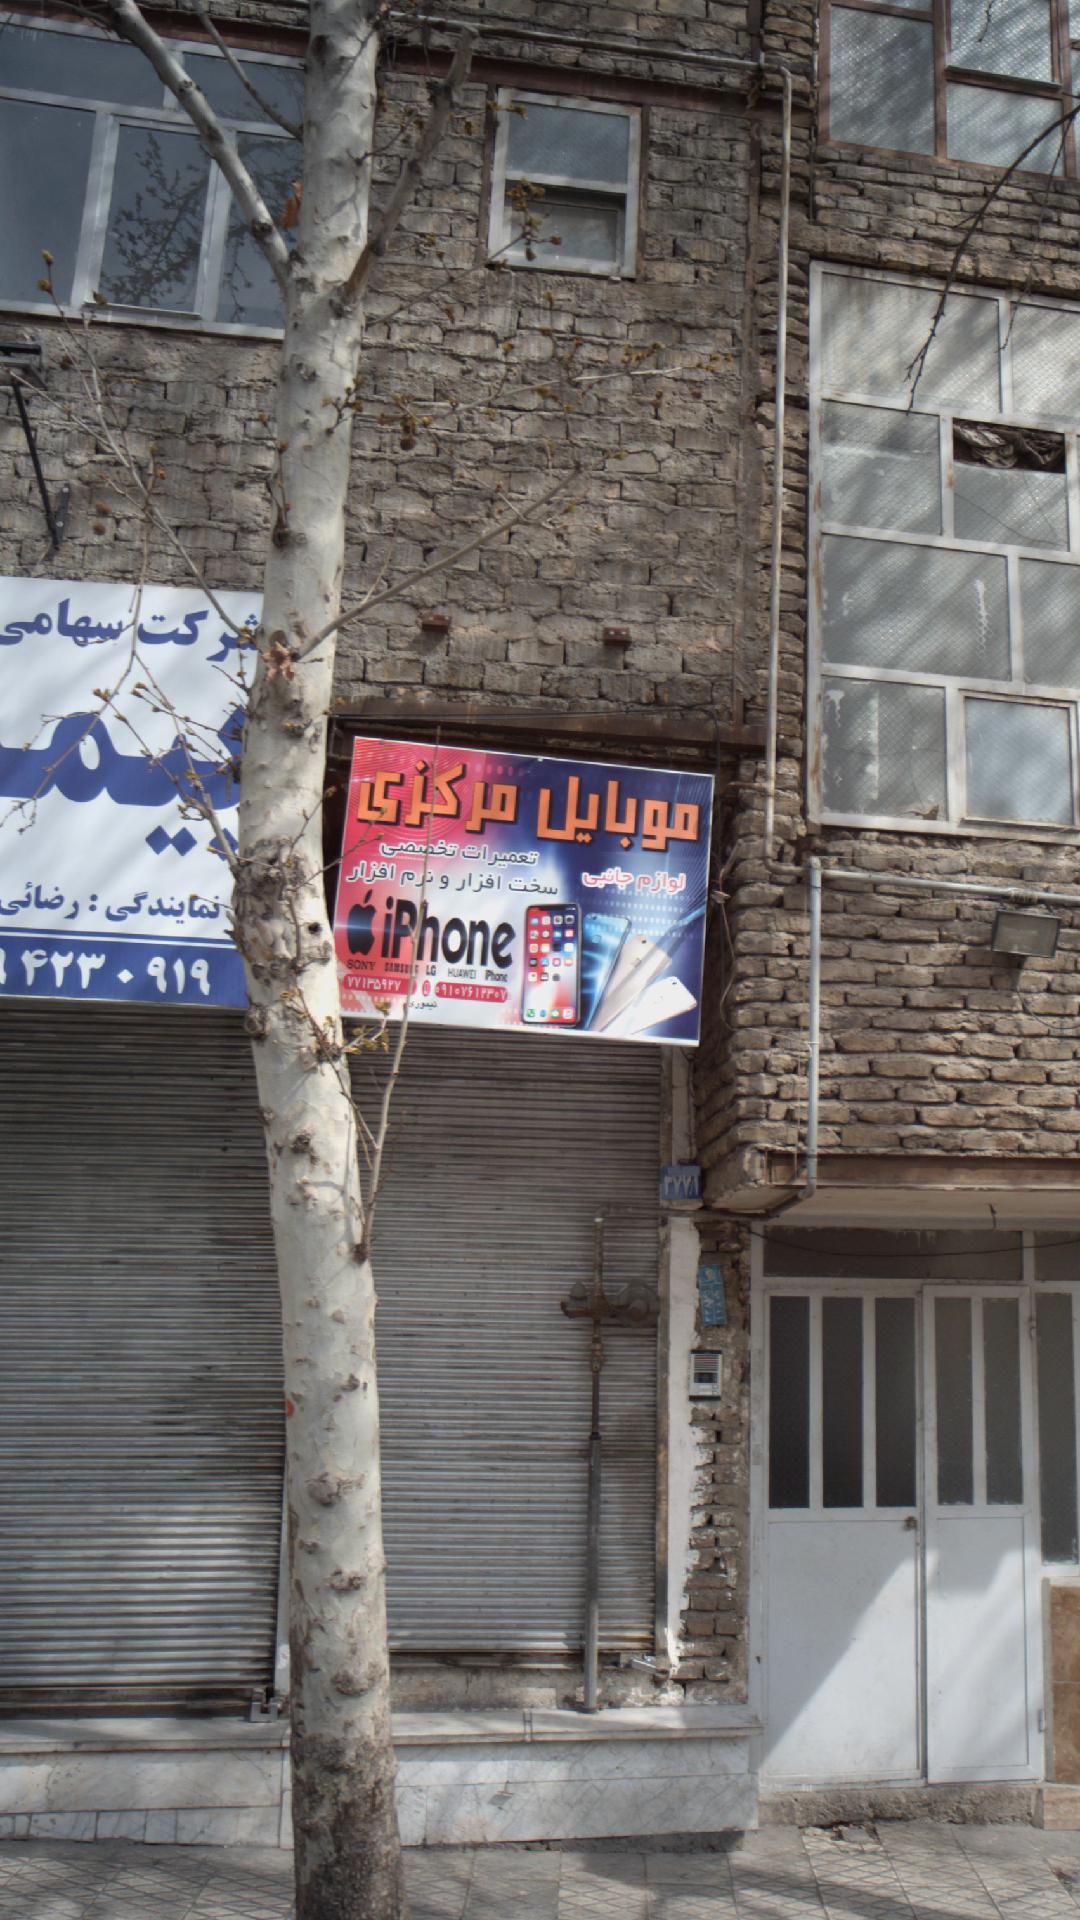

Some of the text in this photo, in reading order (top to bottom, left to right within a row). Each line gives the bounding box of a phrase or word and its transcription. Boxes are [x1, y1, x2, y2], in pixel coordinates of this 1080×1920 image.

[357, 760, 700, 850] موبایل مرکزی
[381, 841, 538, 866] تعمیرات تخصصی
[348, 862, 558, 894] سخت افزار و نرم افزار
[583, 867, 685, 894] لوازم جانبی
[381, 895, 516, 969] iPhone
[346, 959, 376, 971] SONY
[425, 964, 437, 976] LG
[447, 967, 477, 979] HUAWEI
